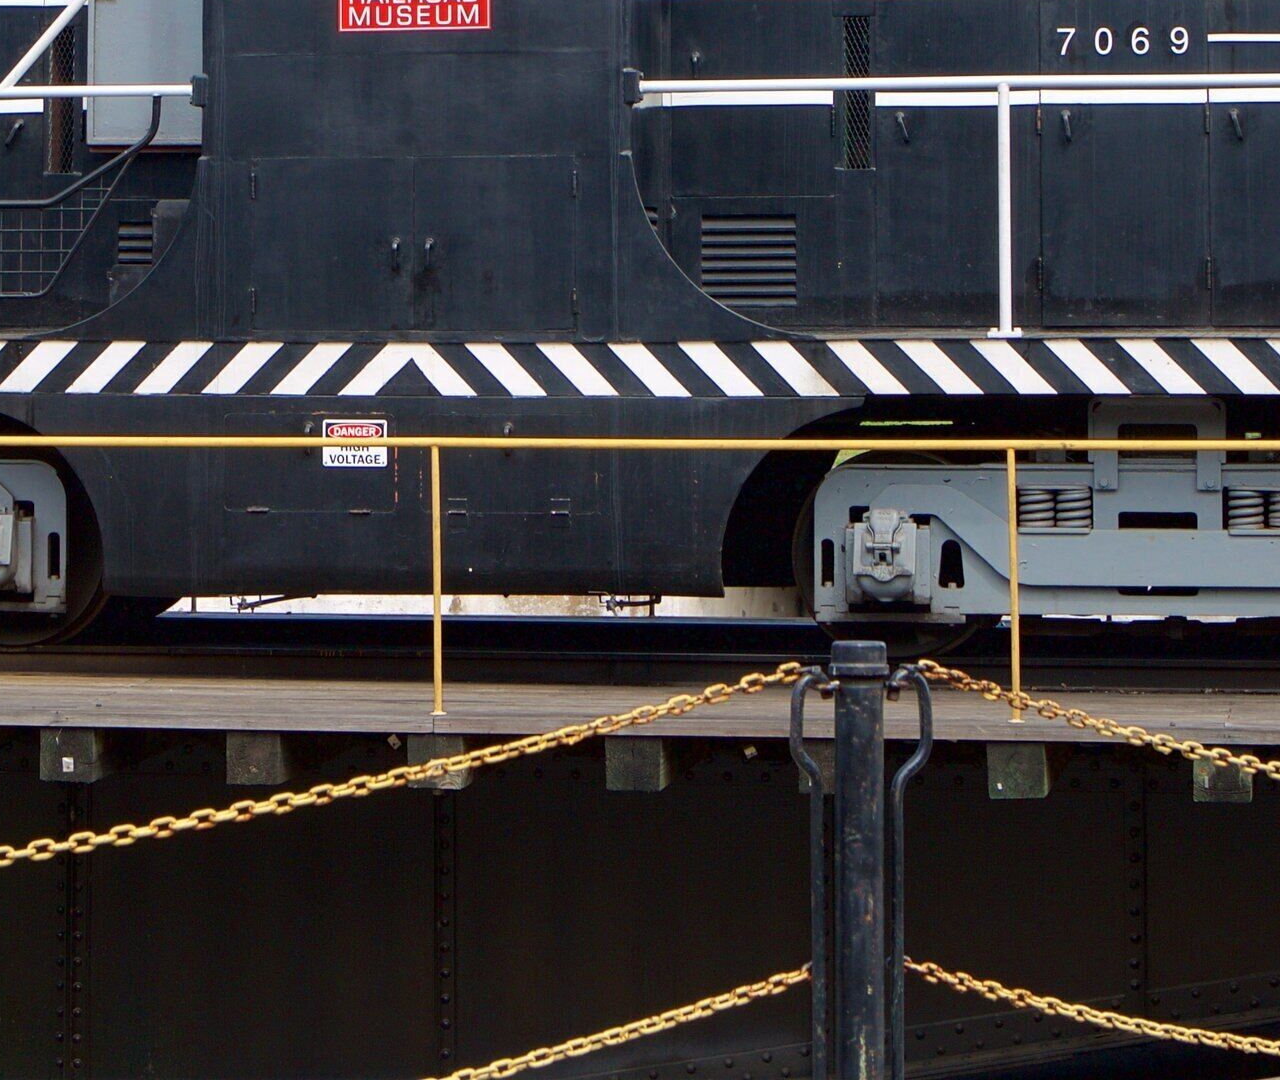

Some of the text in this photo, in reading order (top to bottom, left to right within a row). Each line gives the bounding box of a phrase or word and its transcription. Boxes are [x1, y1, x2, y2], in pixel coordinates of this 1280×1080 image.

[349, 4, 479, 26] MUSEUM
[1056, 27, 1189, 56] 7069
[333, 427, 377, 437] DANGER
[329, 454, 381, 465] VOLTAGE
